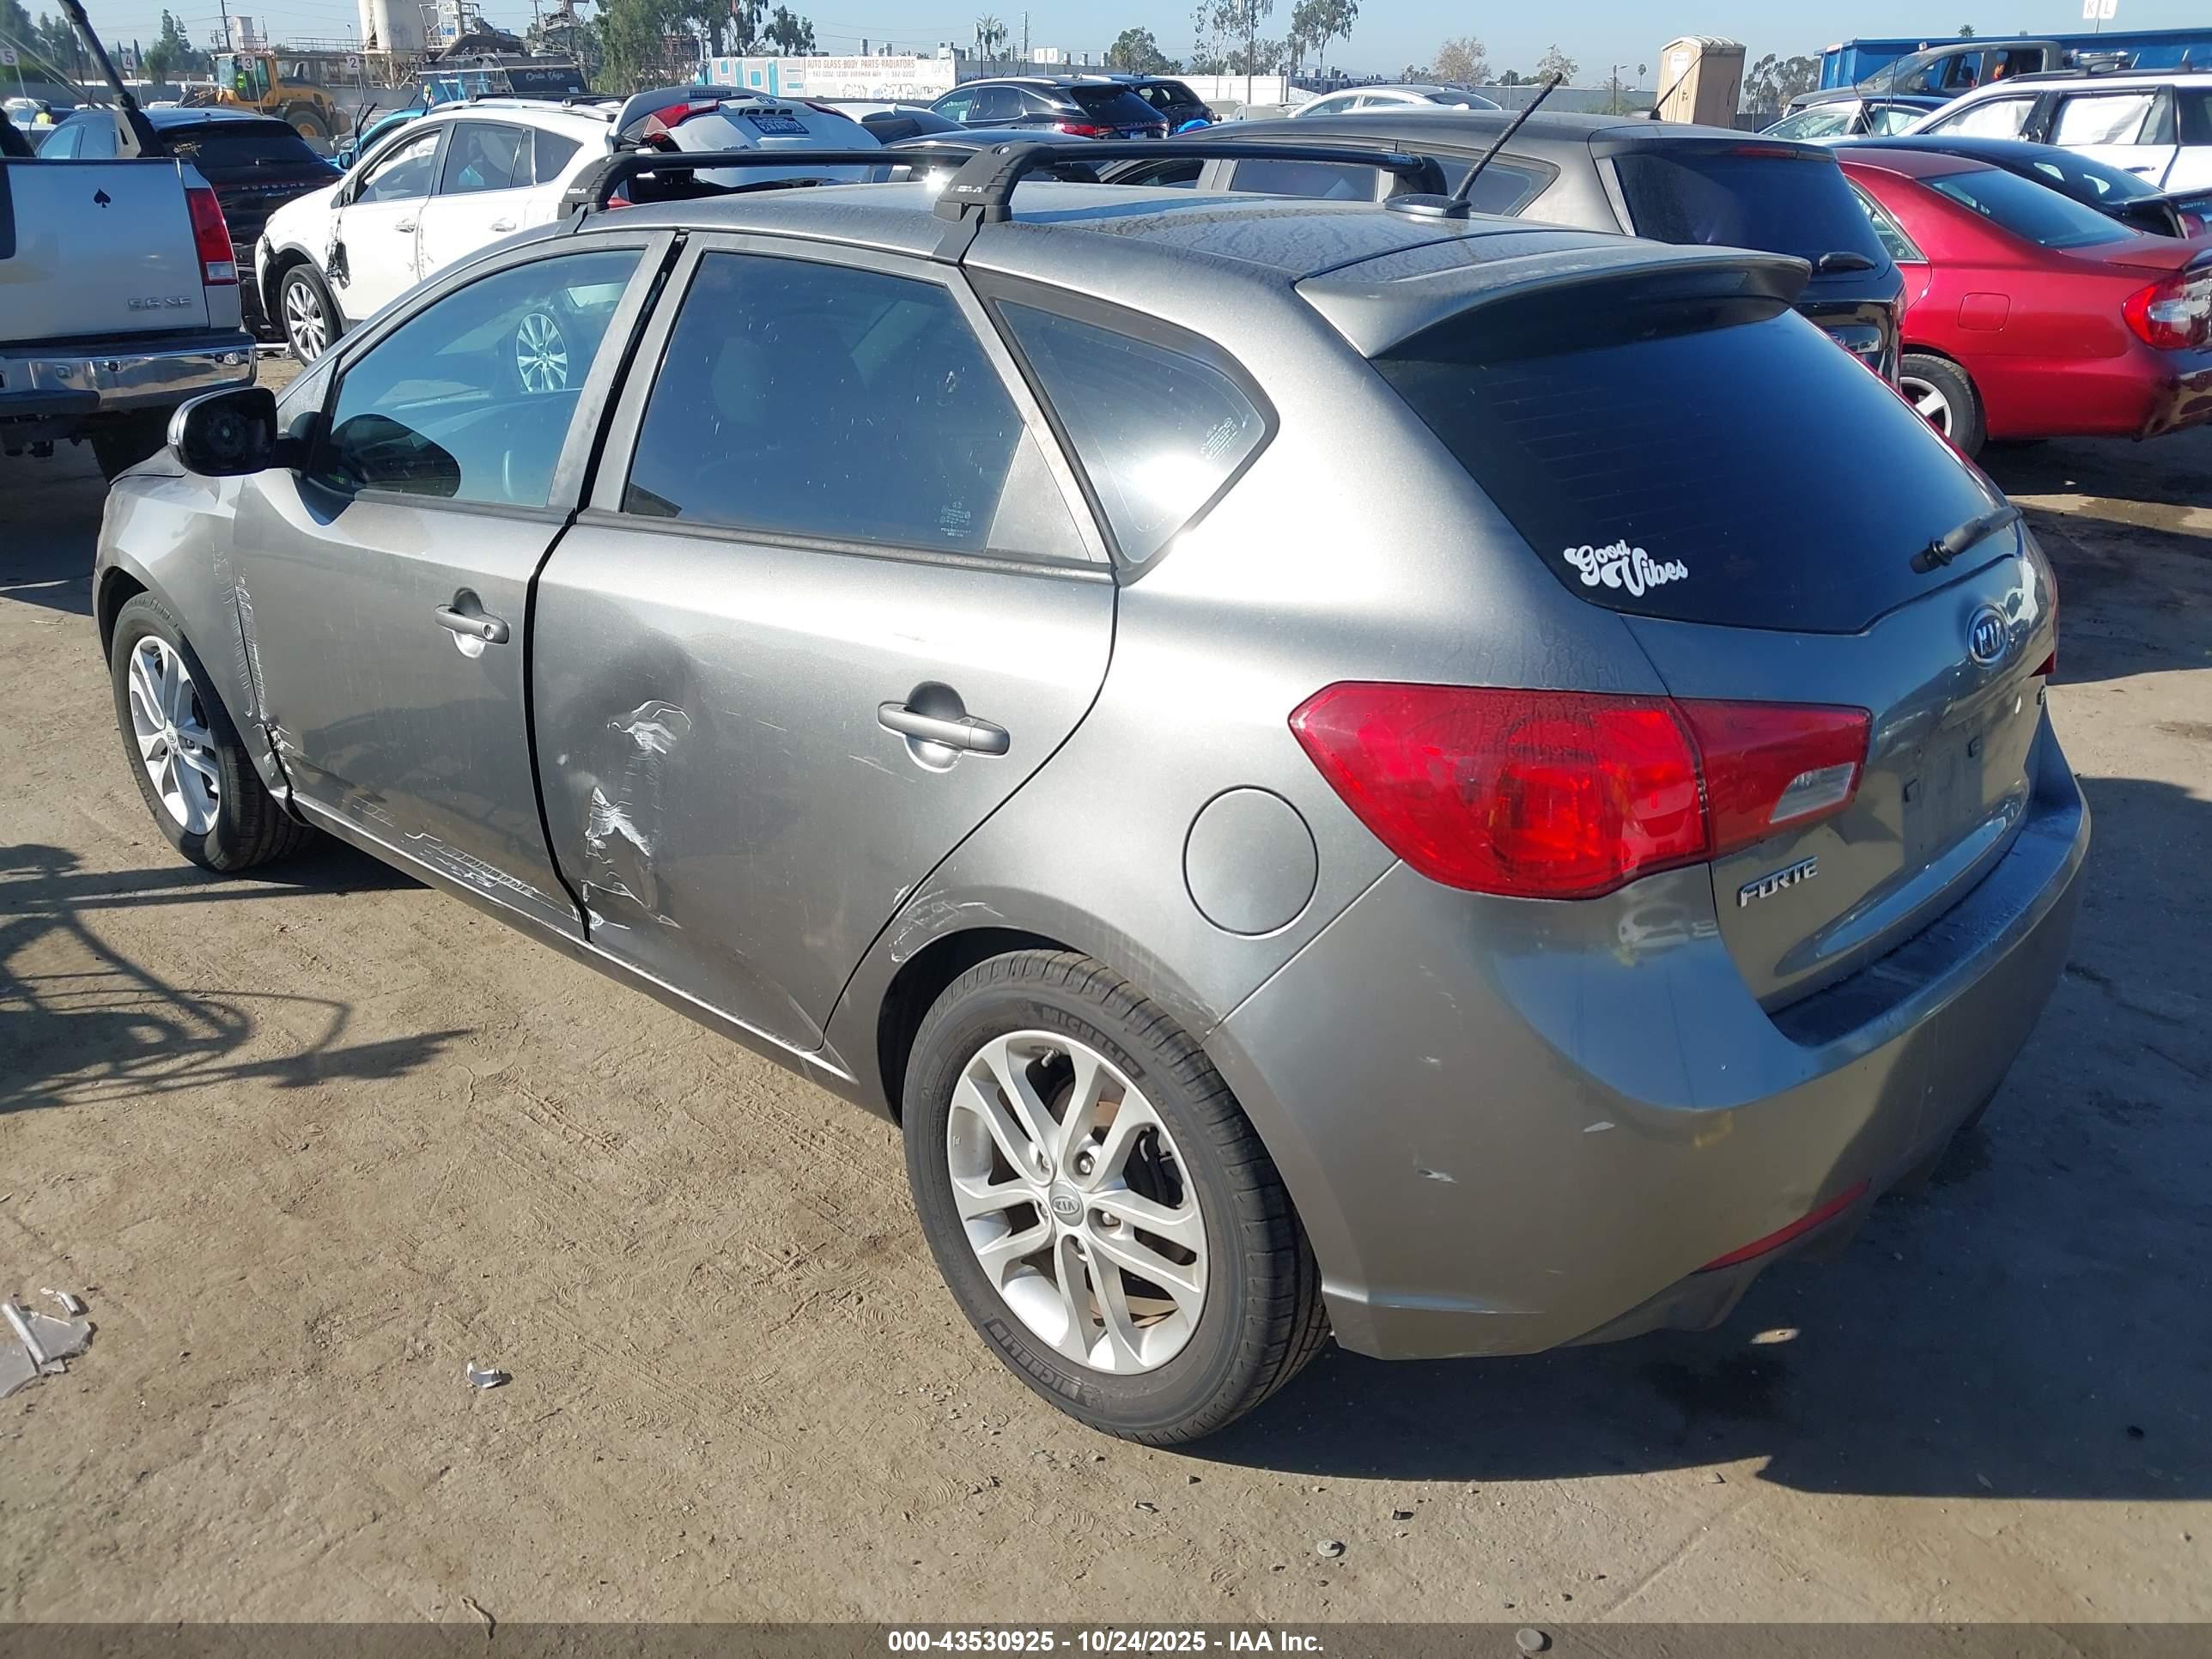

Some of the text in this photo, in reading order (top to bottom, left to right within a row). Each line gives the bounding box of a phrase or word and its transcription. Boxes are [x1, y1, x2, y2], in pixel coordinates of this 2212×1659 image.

[2087, 0, 2095, 15] K
[5, 52, 15, 64] 5
[125, 56, 133, 68] 4
[244, 58, 253, 70] 3
[349, 57, 358, 69] 2
[807, 59, 822, 69] AUTO
[241, 182, 305, 191] PORSCHE
[1564, 539, 1688, 597] Good Vibes
[1976, 618, 2006, 656] KIA
[1736, 856, 1819, 908] FORTE
[1042, 1006, 1144, 1079] MICHELIN
[1053, 1200, 1077, 1212] KIA
[988, 1322, 1082, 1401] MICHELIN
